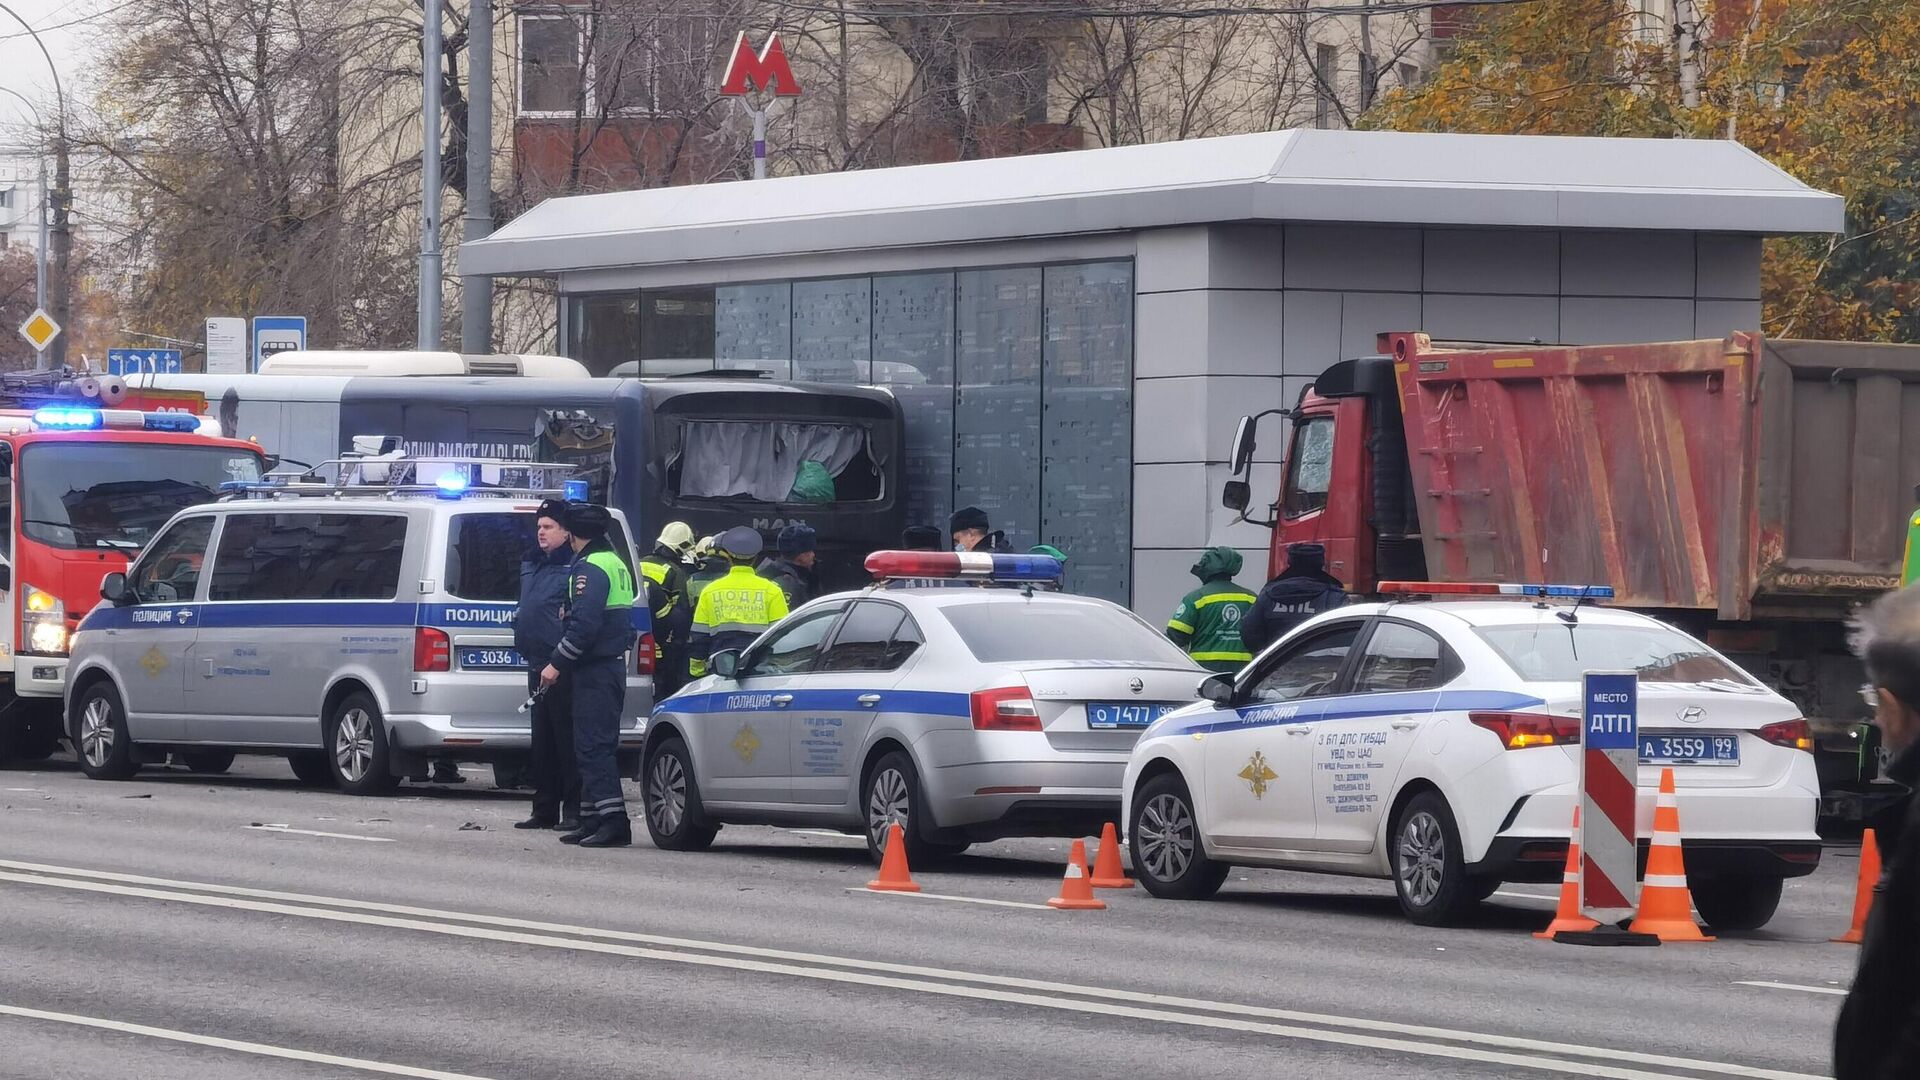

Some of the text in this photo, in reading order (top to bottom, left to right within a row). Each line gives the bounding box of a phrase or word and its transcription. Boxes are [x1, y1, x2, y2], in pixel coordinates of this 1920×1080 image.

[132, 610, 172, 624] ПОЛИЦИЯ
[481, 651, 512, 664] 3036
[727, 694, 772, 710] ПОЛИЦИЯ
[1594, 693, 1628, 703] МЕСТО
[1111, 706, 1150, 722] 7477
[1242, 705, 1299, 724] ПОЛИЦИЯ
[1591, 714, 1632, 734] ДТП
[1340, 733, 1357, 746] ДПС
[1359, 732, 1387, 745] ГИБДД
[1661, 738, 1705, 757] 3559
[1715, 738, 1732, 752] 99
